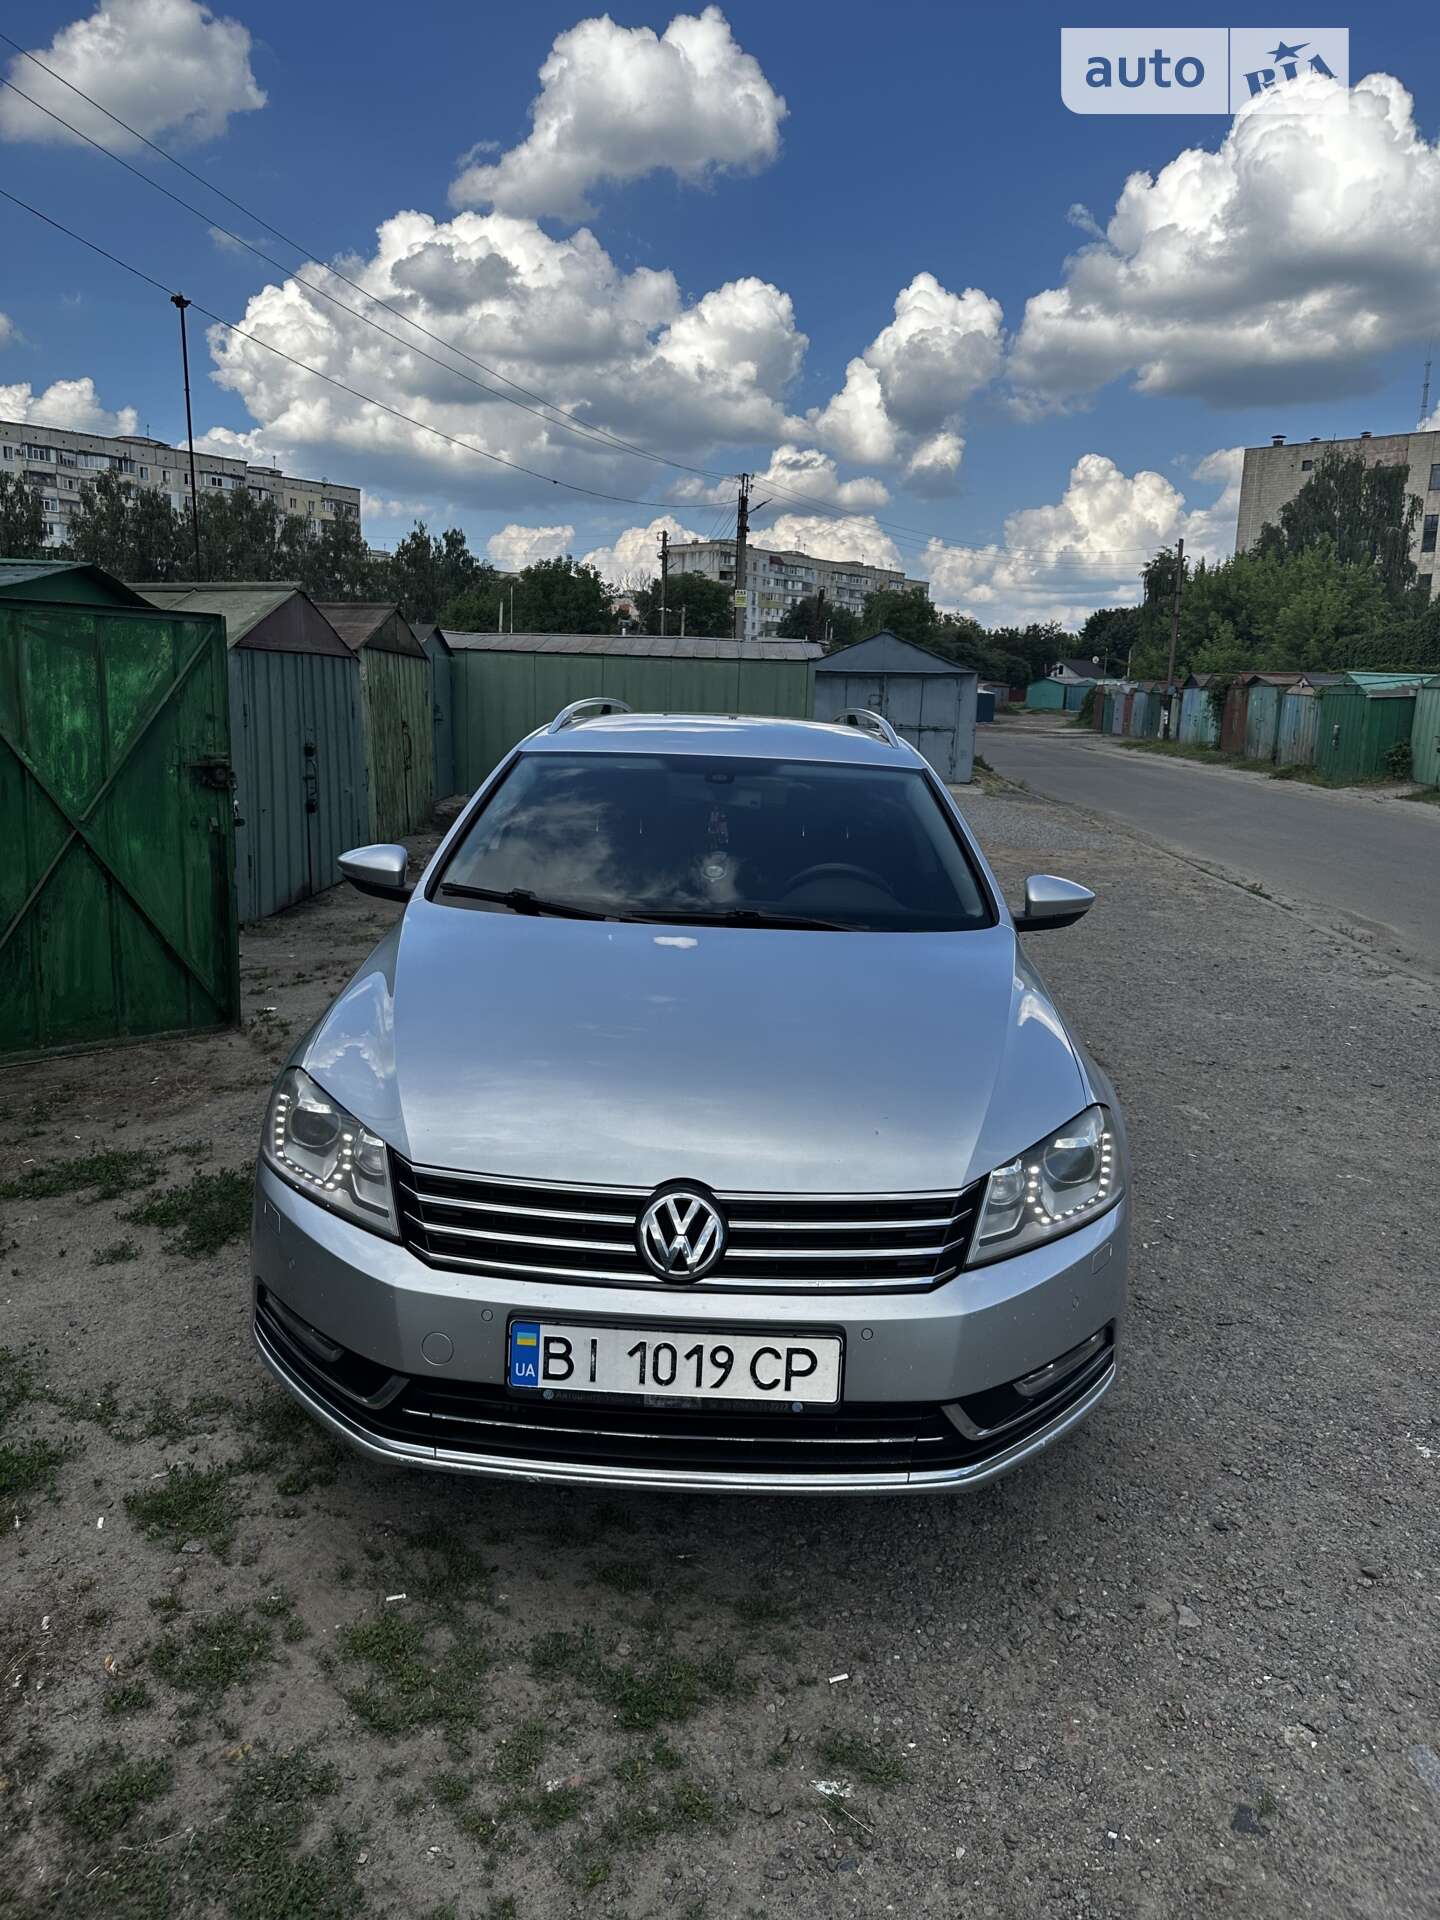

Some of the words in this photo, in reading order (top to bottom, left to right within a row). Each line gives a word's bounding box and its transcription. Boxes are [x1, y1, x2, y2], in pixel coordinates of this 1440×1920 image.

[515, 1362, 536, 1377] UA
[543, 1336, 598, 1382] BI
[627, 1341, 735, 1389] 1019
[750, 1346, 818, 1392] CP
